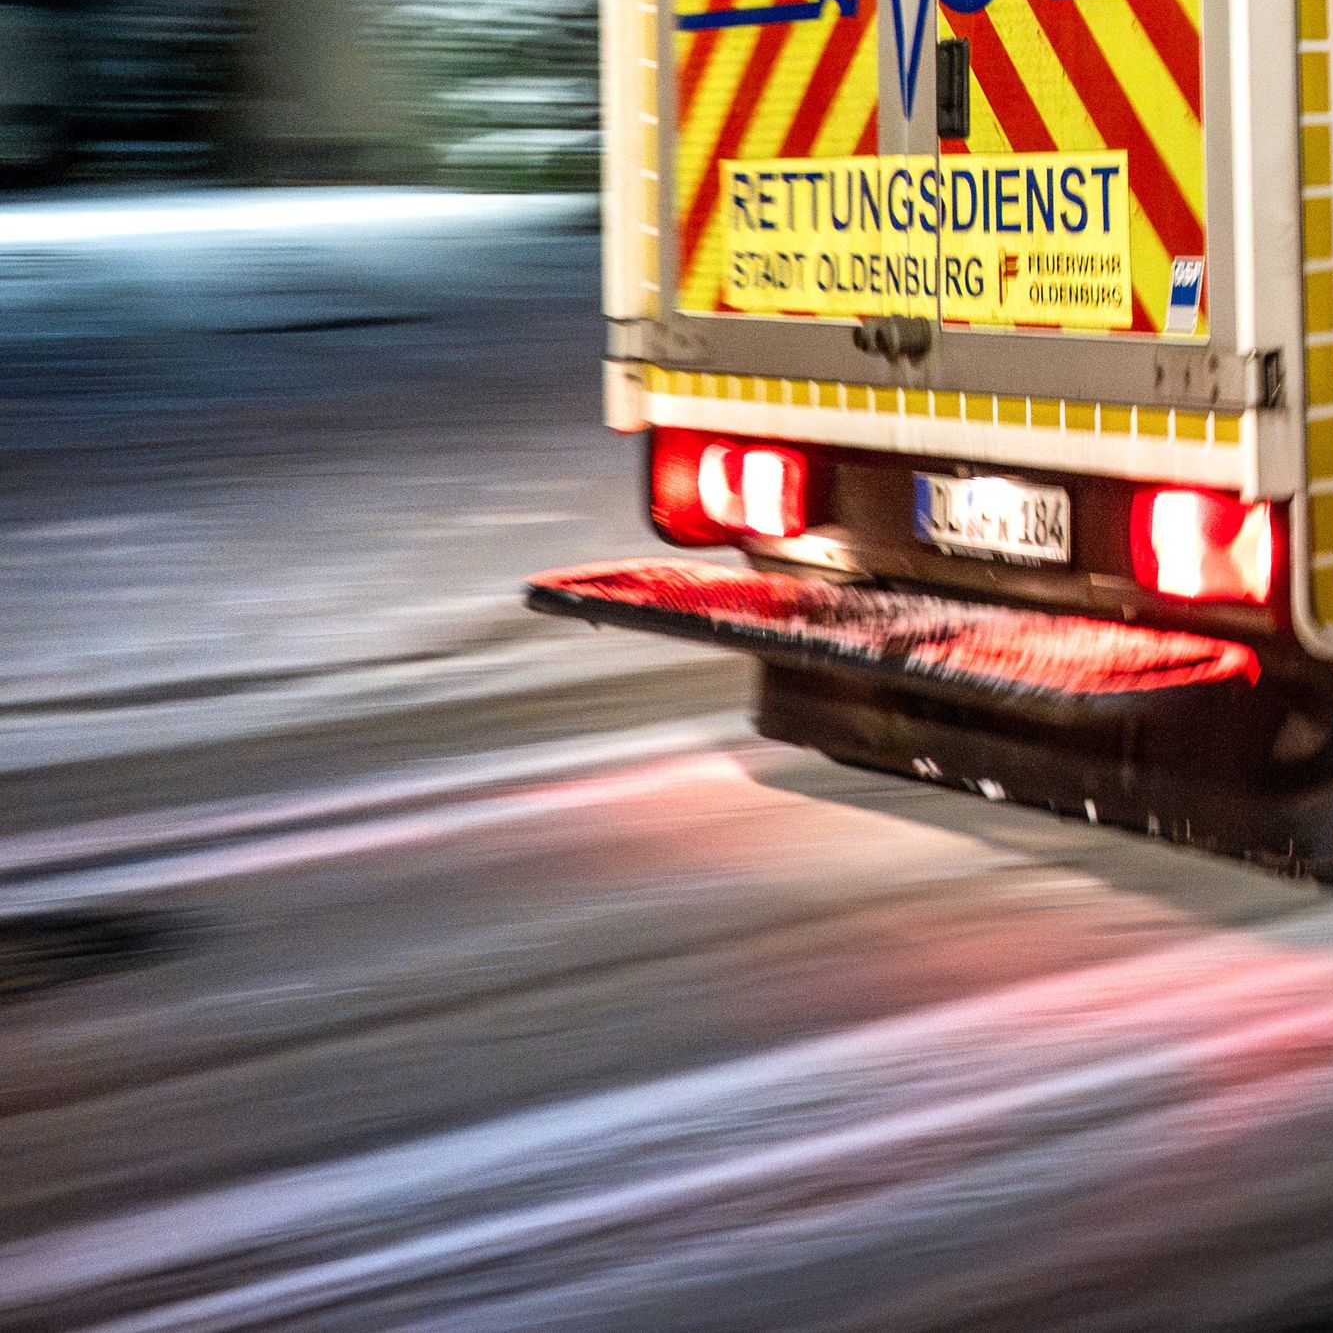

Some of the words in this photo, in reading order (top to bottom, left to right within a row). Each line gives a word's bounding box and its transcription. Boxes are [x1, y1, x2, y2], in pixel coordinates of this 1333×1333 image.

[733, 166, 1119, 234] RETTUNGSDIENST
[733, 251, 806, 291] STADT
[816, 252, 984, 298] OLDENBURG
[1028, 251, 1121, 277] FEUERWEHR
[1029, 280, 1123, 308] OLDENBURG
[1018, 496, 1065, 546] 184
